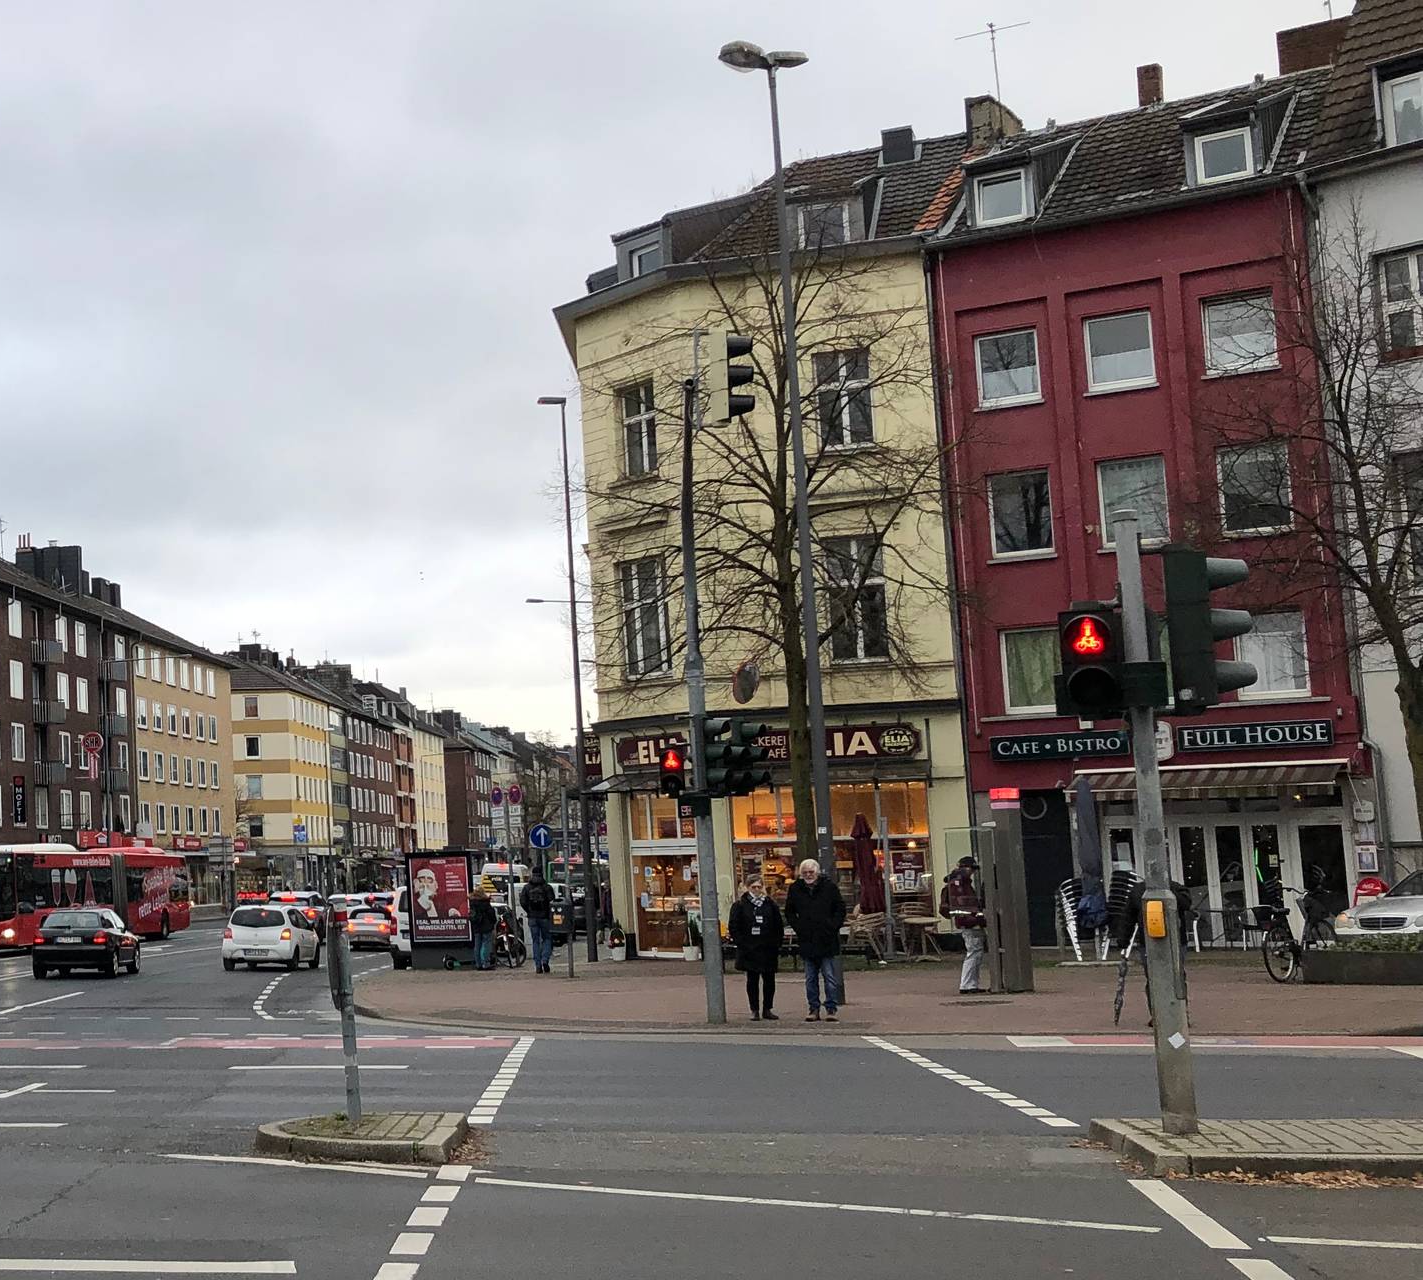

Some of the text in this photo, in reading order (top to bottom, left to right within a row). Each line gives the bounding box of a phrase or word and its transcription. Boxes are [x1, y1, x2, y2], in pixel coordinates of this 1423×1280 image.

[751, 735, 787, 747] KEREI
[884, 735, 910, 744] ELIA
[1182, 729, 1237, 747] FULL
[1244, 722, 1329, 743] HOUSE
[826, 731, 878, 756] IA
[767, 745, 788, 759] AFÉ
